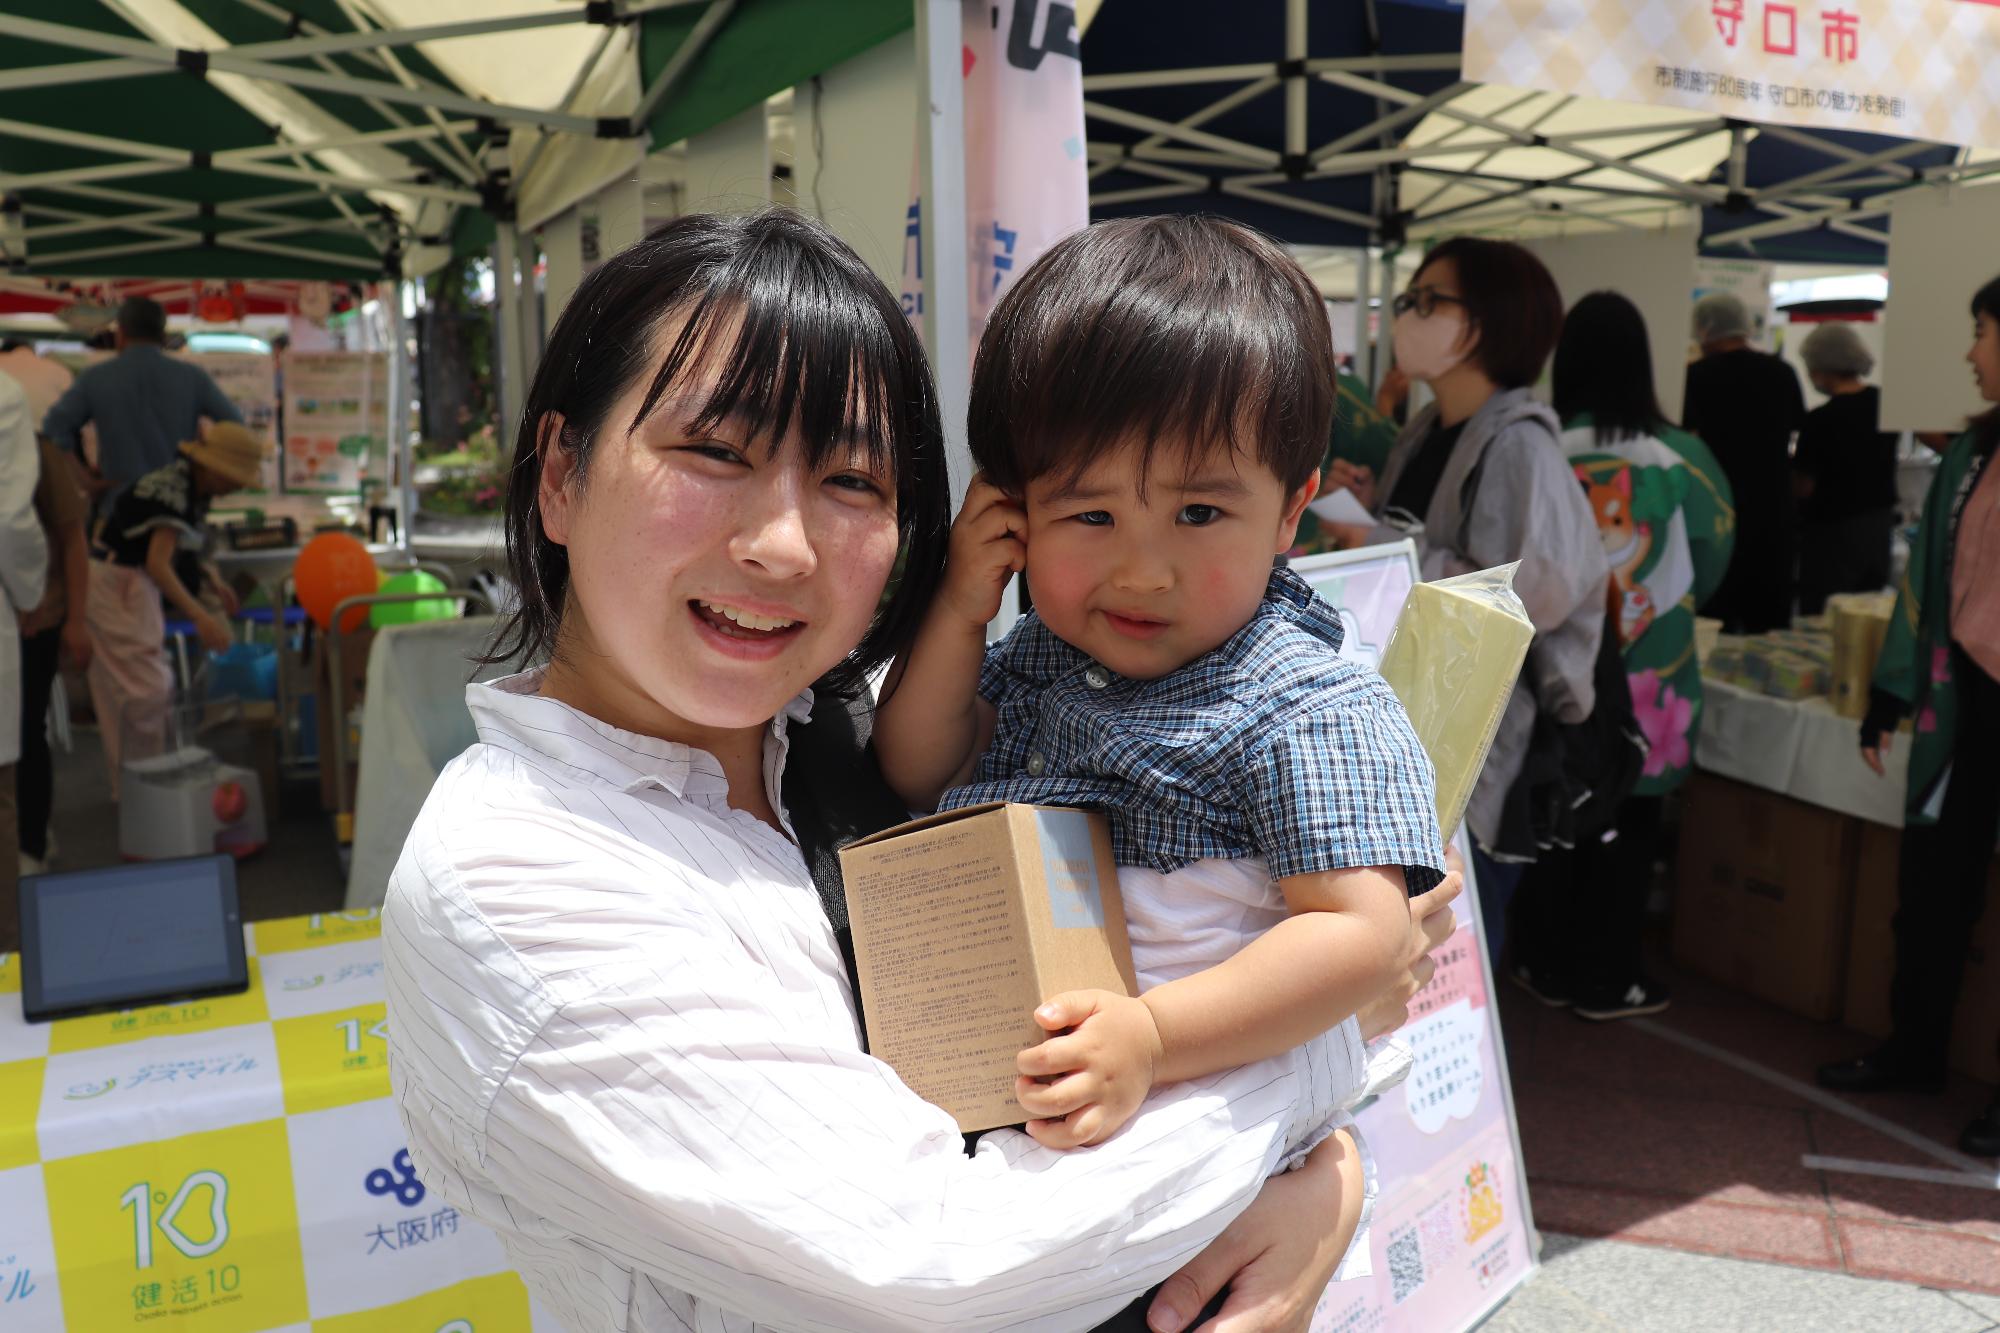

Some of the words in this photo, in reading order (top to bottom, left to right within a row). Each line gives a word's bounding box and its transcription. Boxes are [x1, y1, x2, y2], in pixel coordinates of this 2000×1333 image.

[1711, 0, 1861, 63] 守口市
[1655, 66, 1763, 101] 市制施行80周年
[365, 1206, 459, 1256] 大阪府
